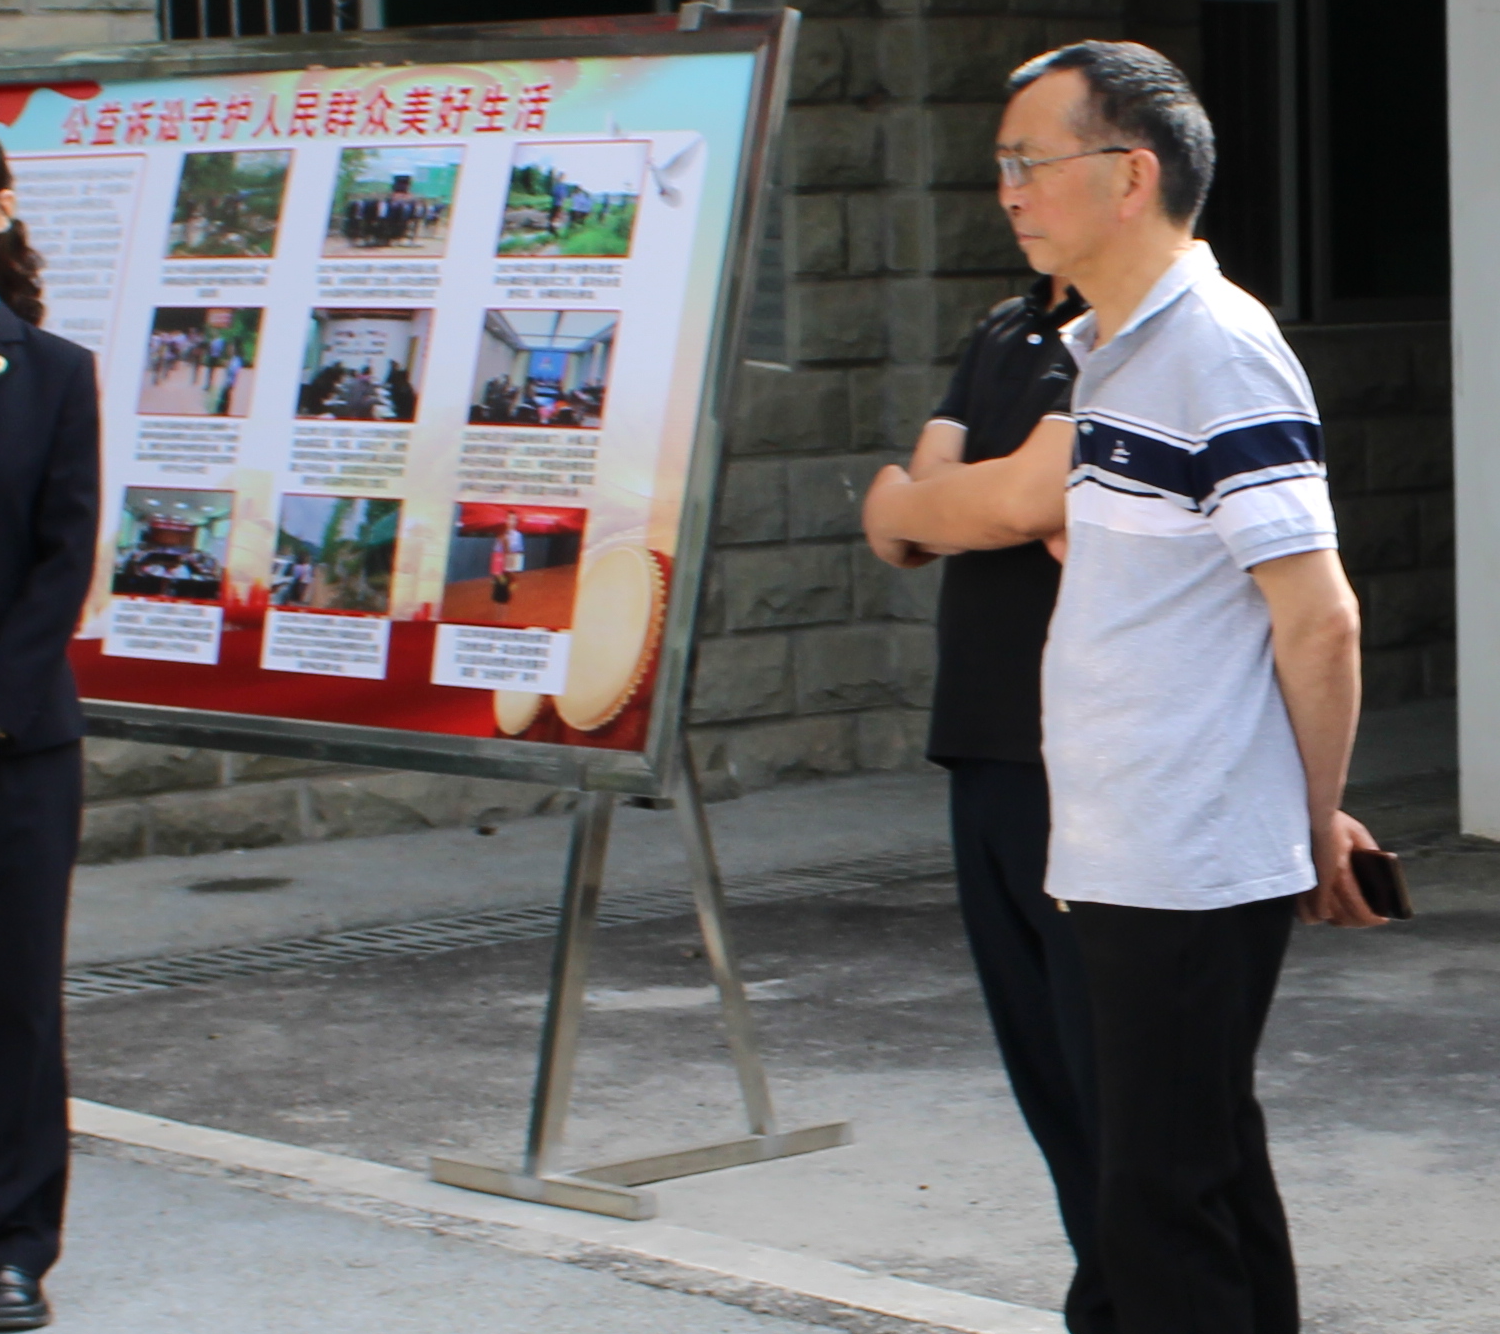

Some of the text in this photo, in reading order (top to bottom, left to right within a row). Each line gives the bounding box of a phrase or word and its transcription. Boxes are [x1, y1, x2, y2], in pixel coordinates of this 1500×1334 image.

[61, 83, 553, 146] 公益诉讼守护人民群众美好生活
